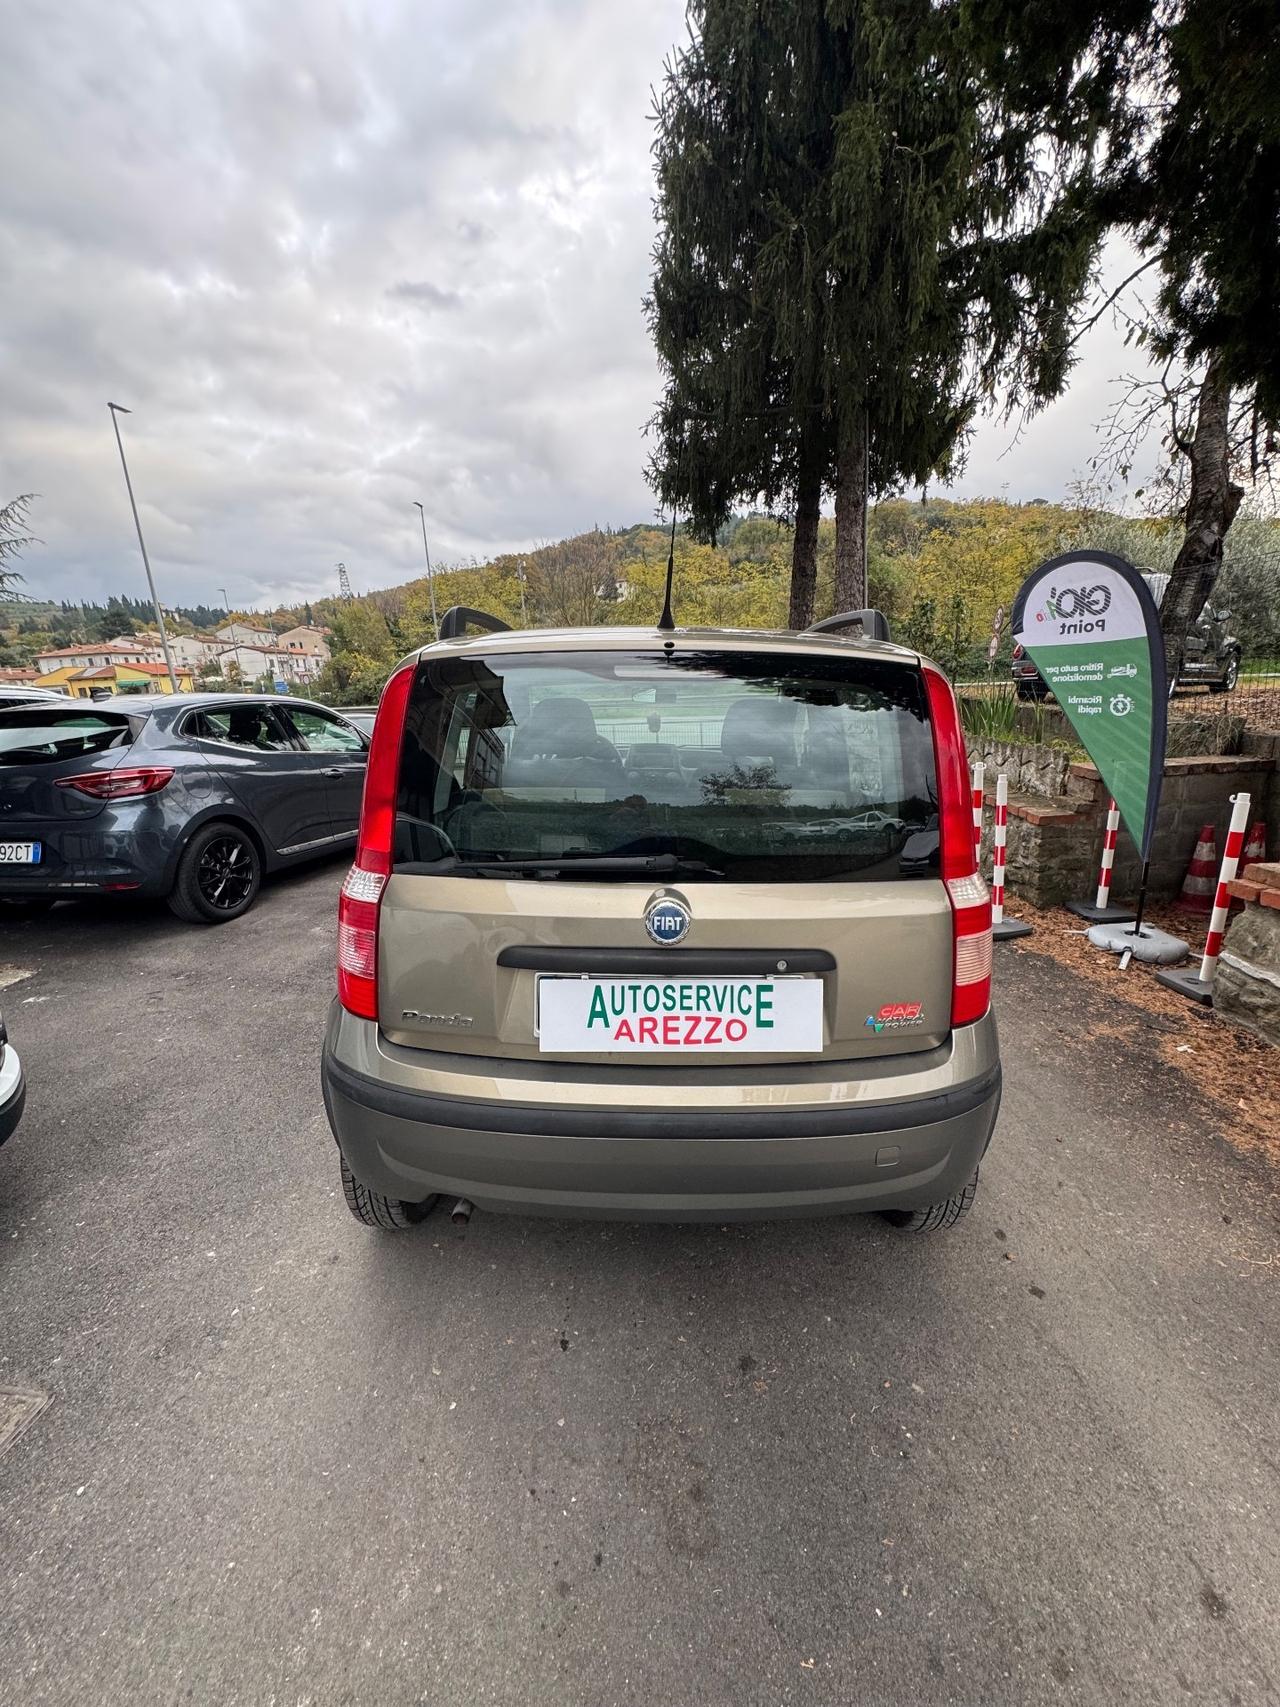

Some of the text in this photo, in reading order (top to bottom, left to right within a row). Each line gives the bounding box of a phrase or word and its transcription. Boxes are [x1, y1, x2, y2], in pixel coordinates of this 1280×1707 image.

[653, 916, 683, 931] FIAT
[587, 984, 774, 1028] AUTOSERVICE
[614, 1015, 748, 1045] AREZZO
